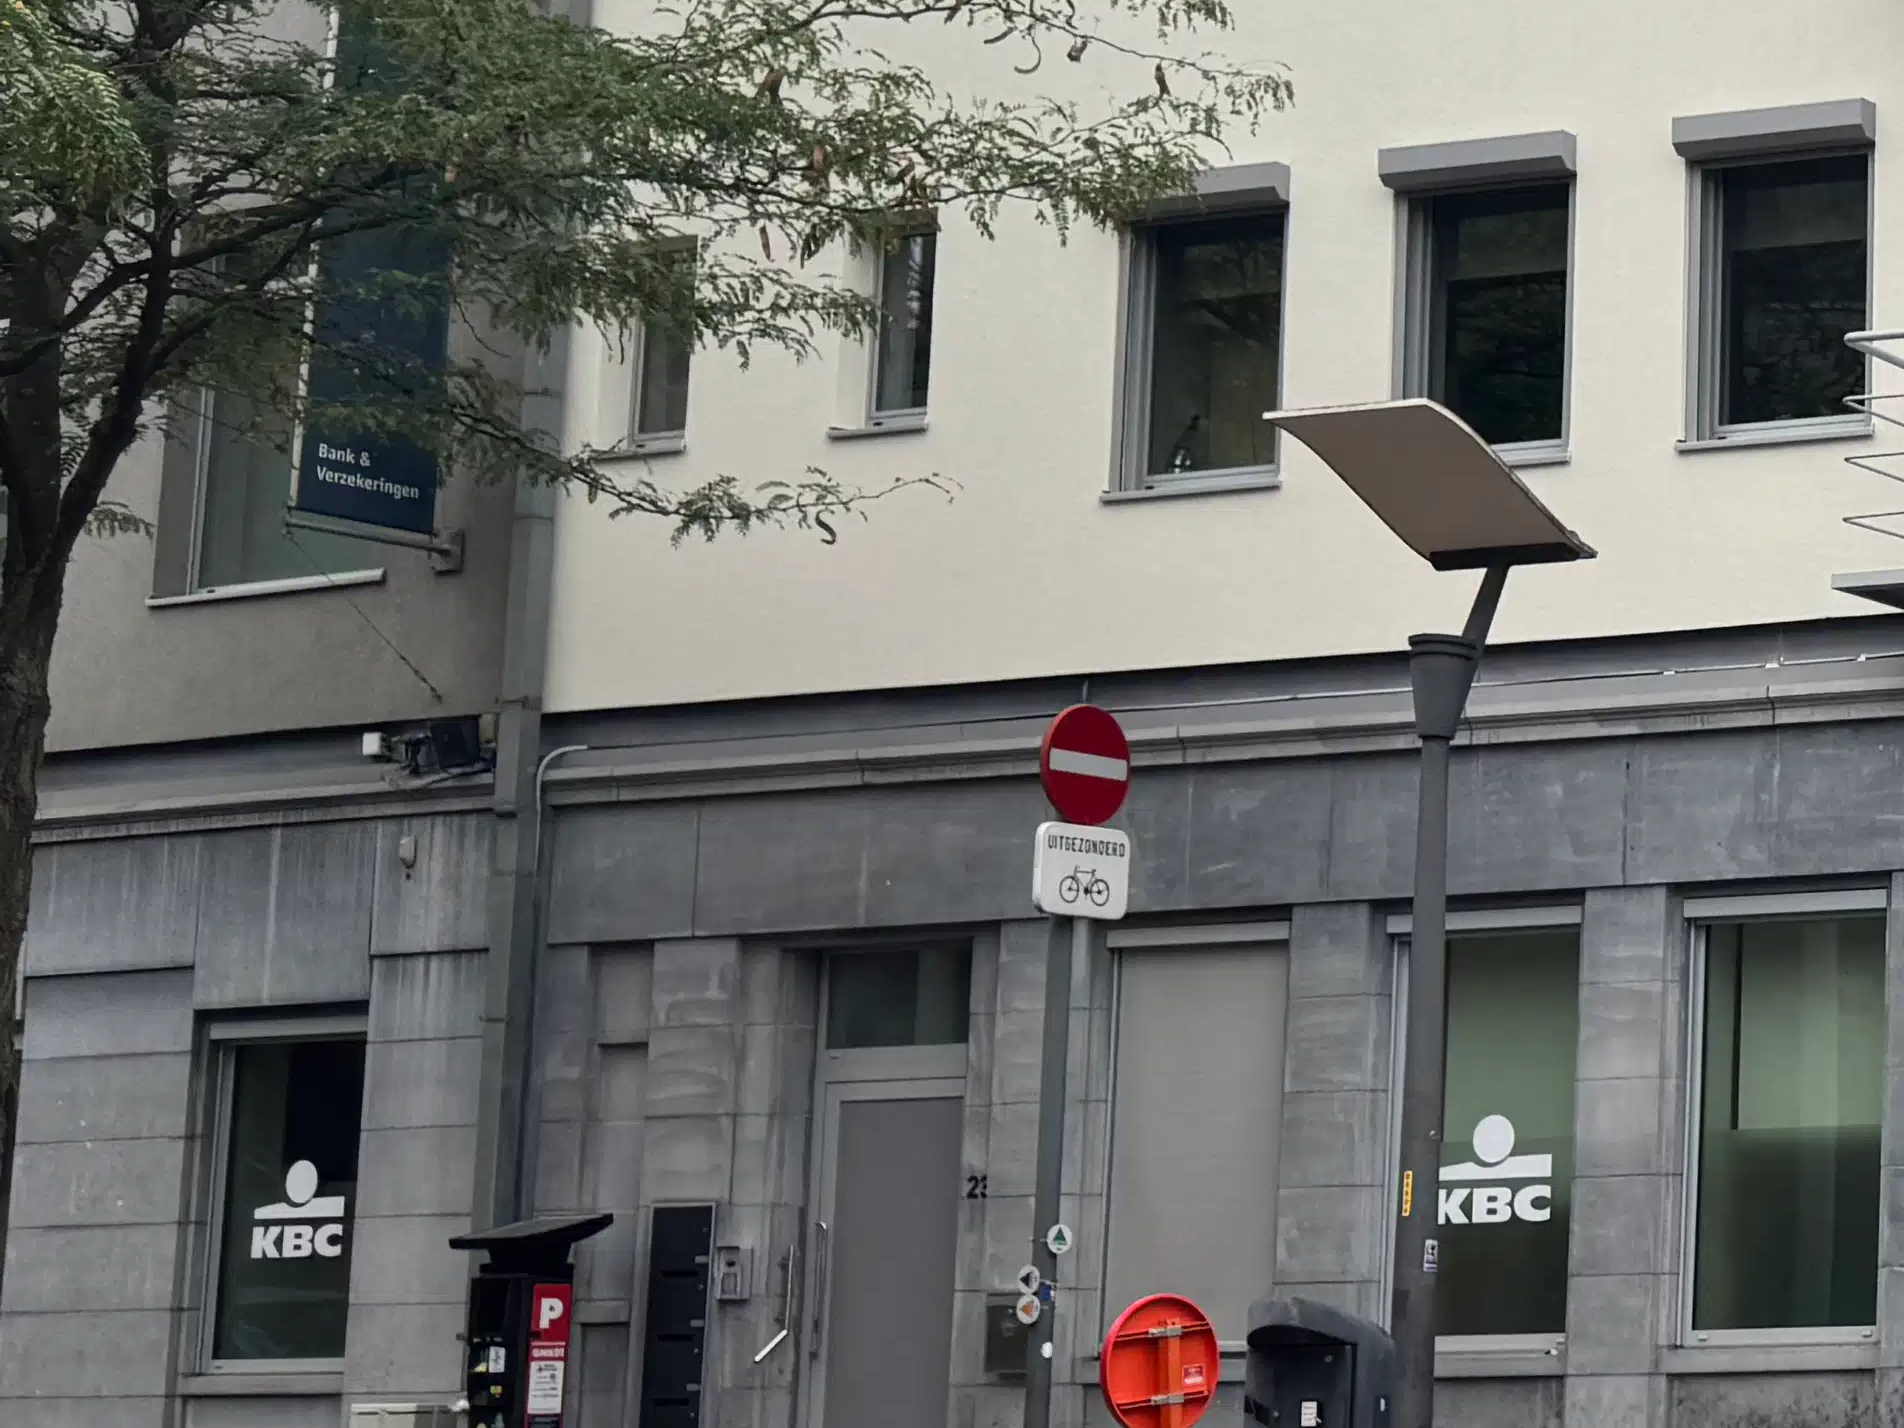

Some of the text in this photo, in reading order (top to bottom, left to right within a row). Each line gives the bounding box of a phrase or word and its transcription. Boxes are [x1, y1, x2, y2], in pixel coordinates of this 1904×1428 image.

[318, 442, 371, 467] Bank &
[316, 464, 420, 500] Verzekeringen
[1047, 834, 1126, 858] UITGEZONDERD
[1436, 1184, 1552, 1225] KBC
[249, 1222, 344, 1260] KBC
[538, 1297, 564, 1330] P
